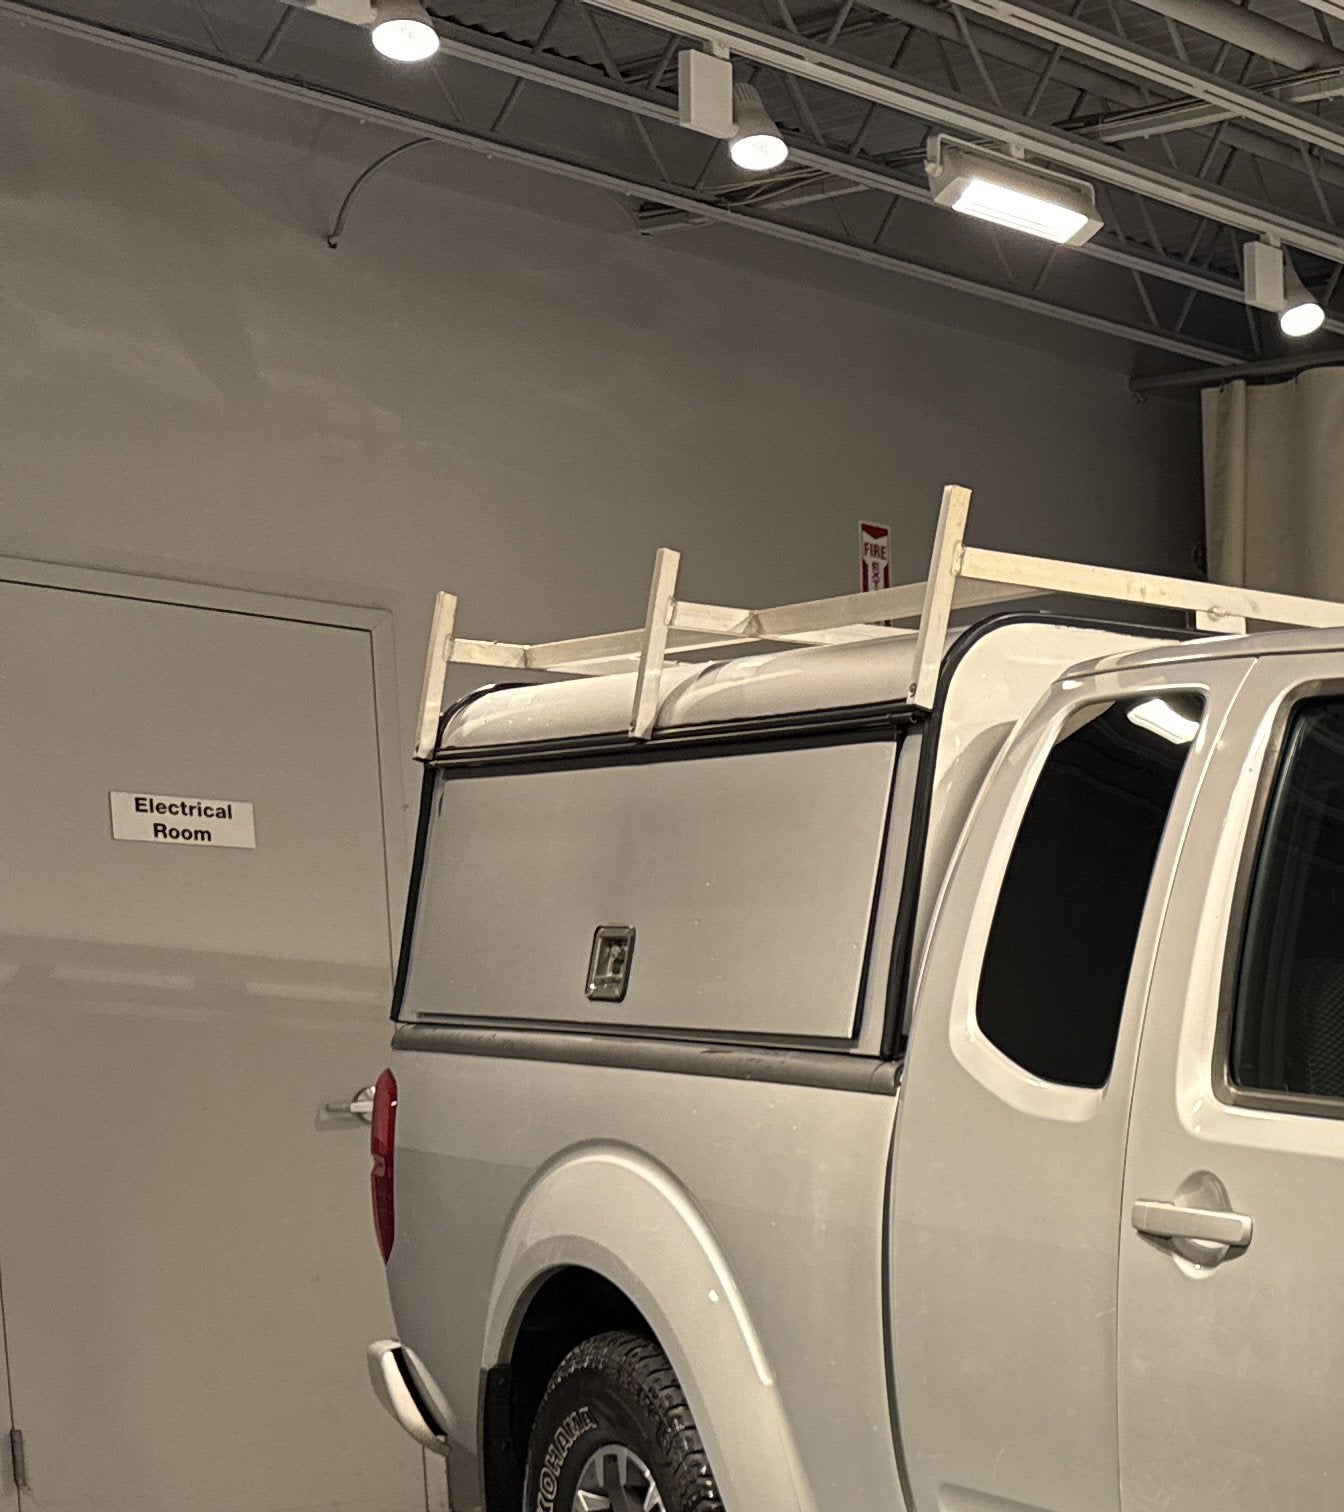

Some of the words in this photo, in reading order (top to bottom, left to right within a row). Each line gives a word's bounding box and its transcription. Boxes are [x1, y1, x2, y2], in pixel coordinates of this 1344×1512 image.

[863, 542, 887, 560] FIRE
[134, 797, 233, 820] Electrical
[153, 822, 212, 842] Room
